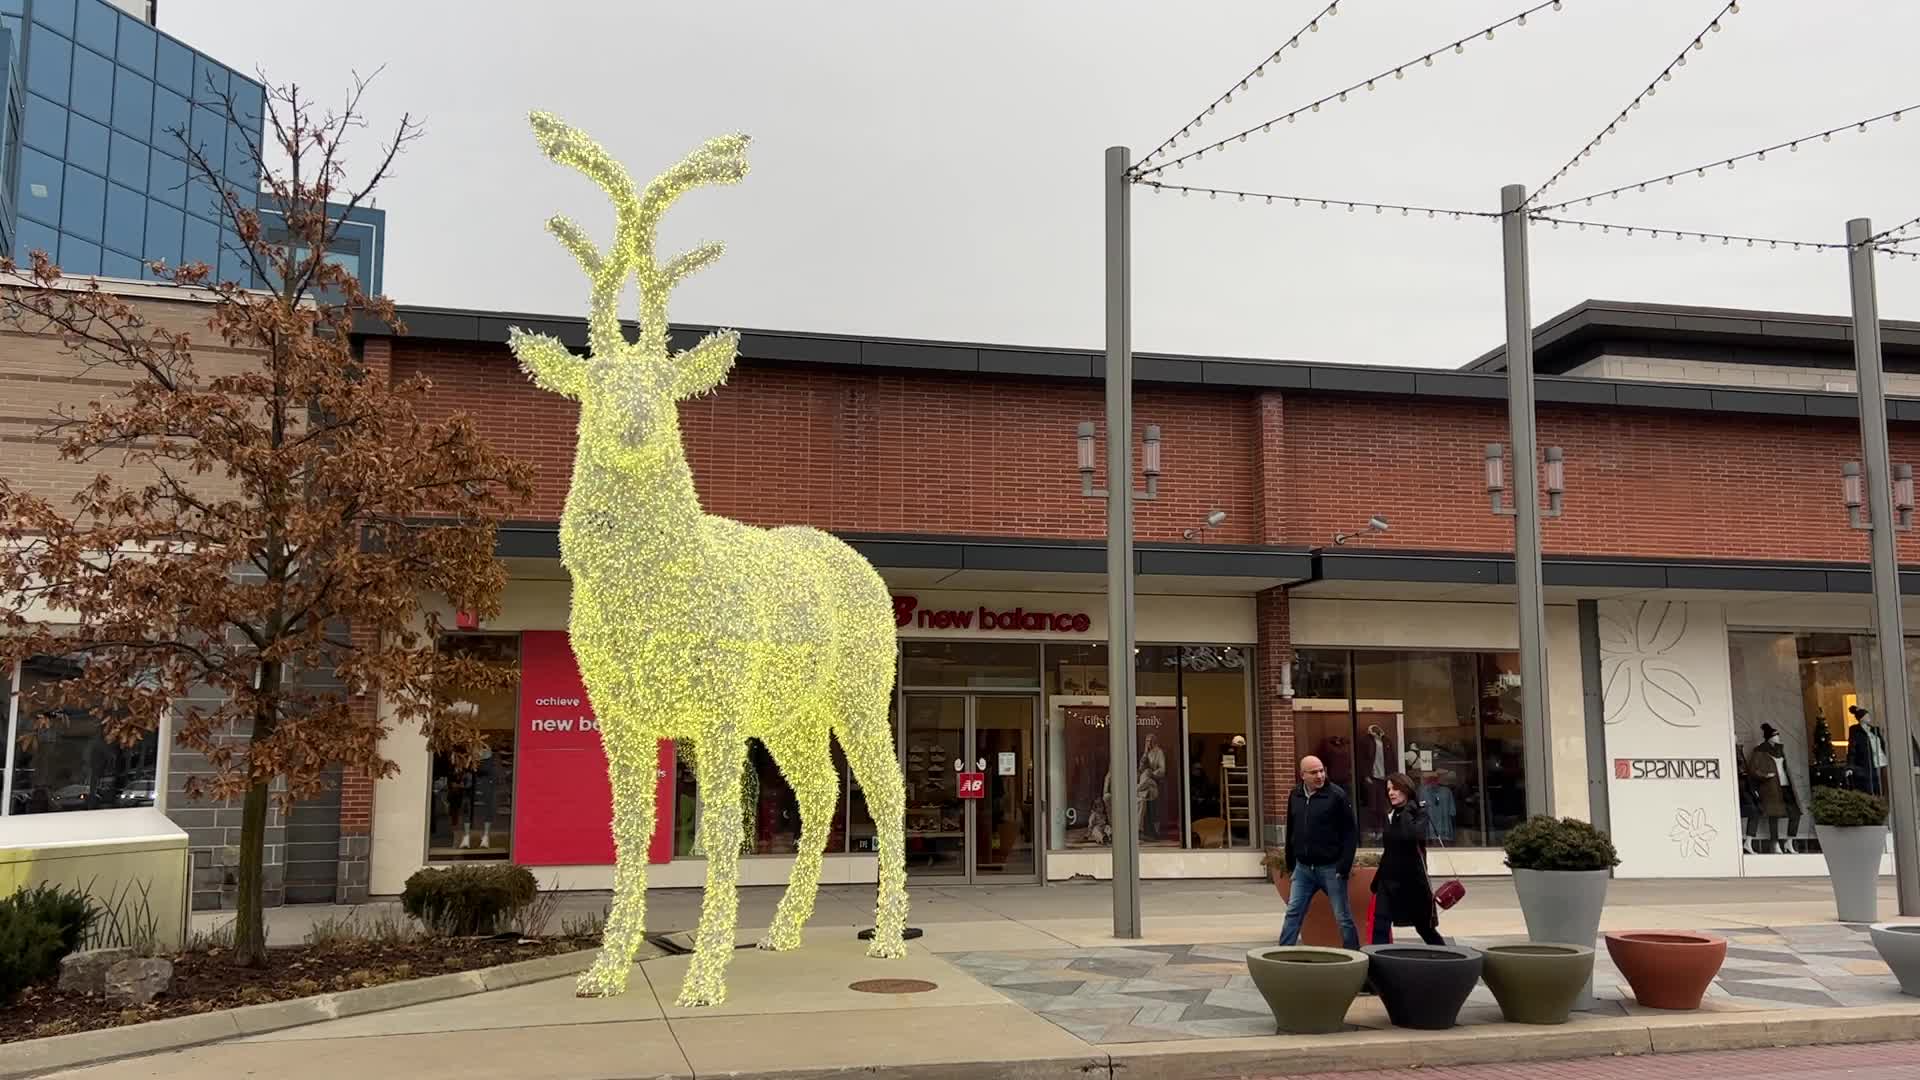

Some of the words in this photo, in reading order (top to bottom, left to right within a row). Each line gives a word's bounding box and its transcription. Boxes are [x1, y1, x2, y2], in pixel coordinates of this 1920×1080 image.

[917, 609, 974, 629] new
[979, 606, 1091, 632] balance
[535, 696, 580, 706] achieve
[531, 719, 574, 732] new
